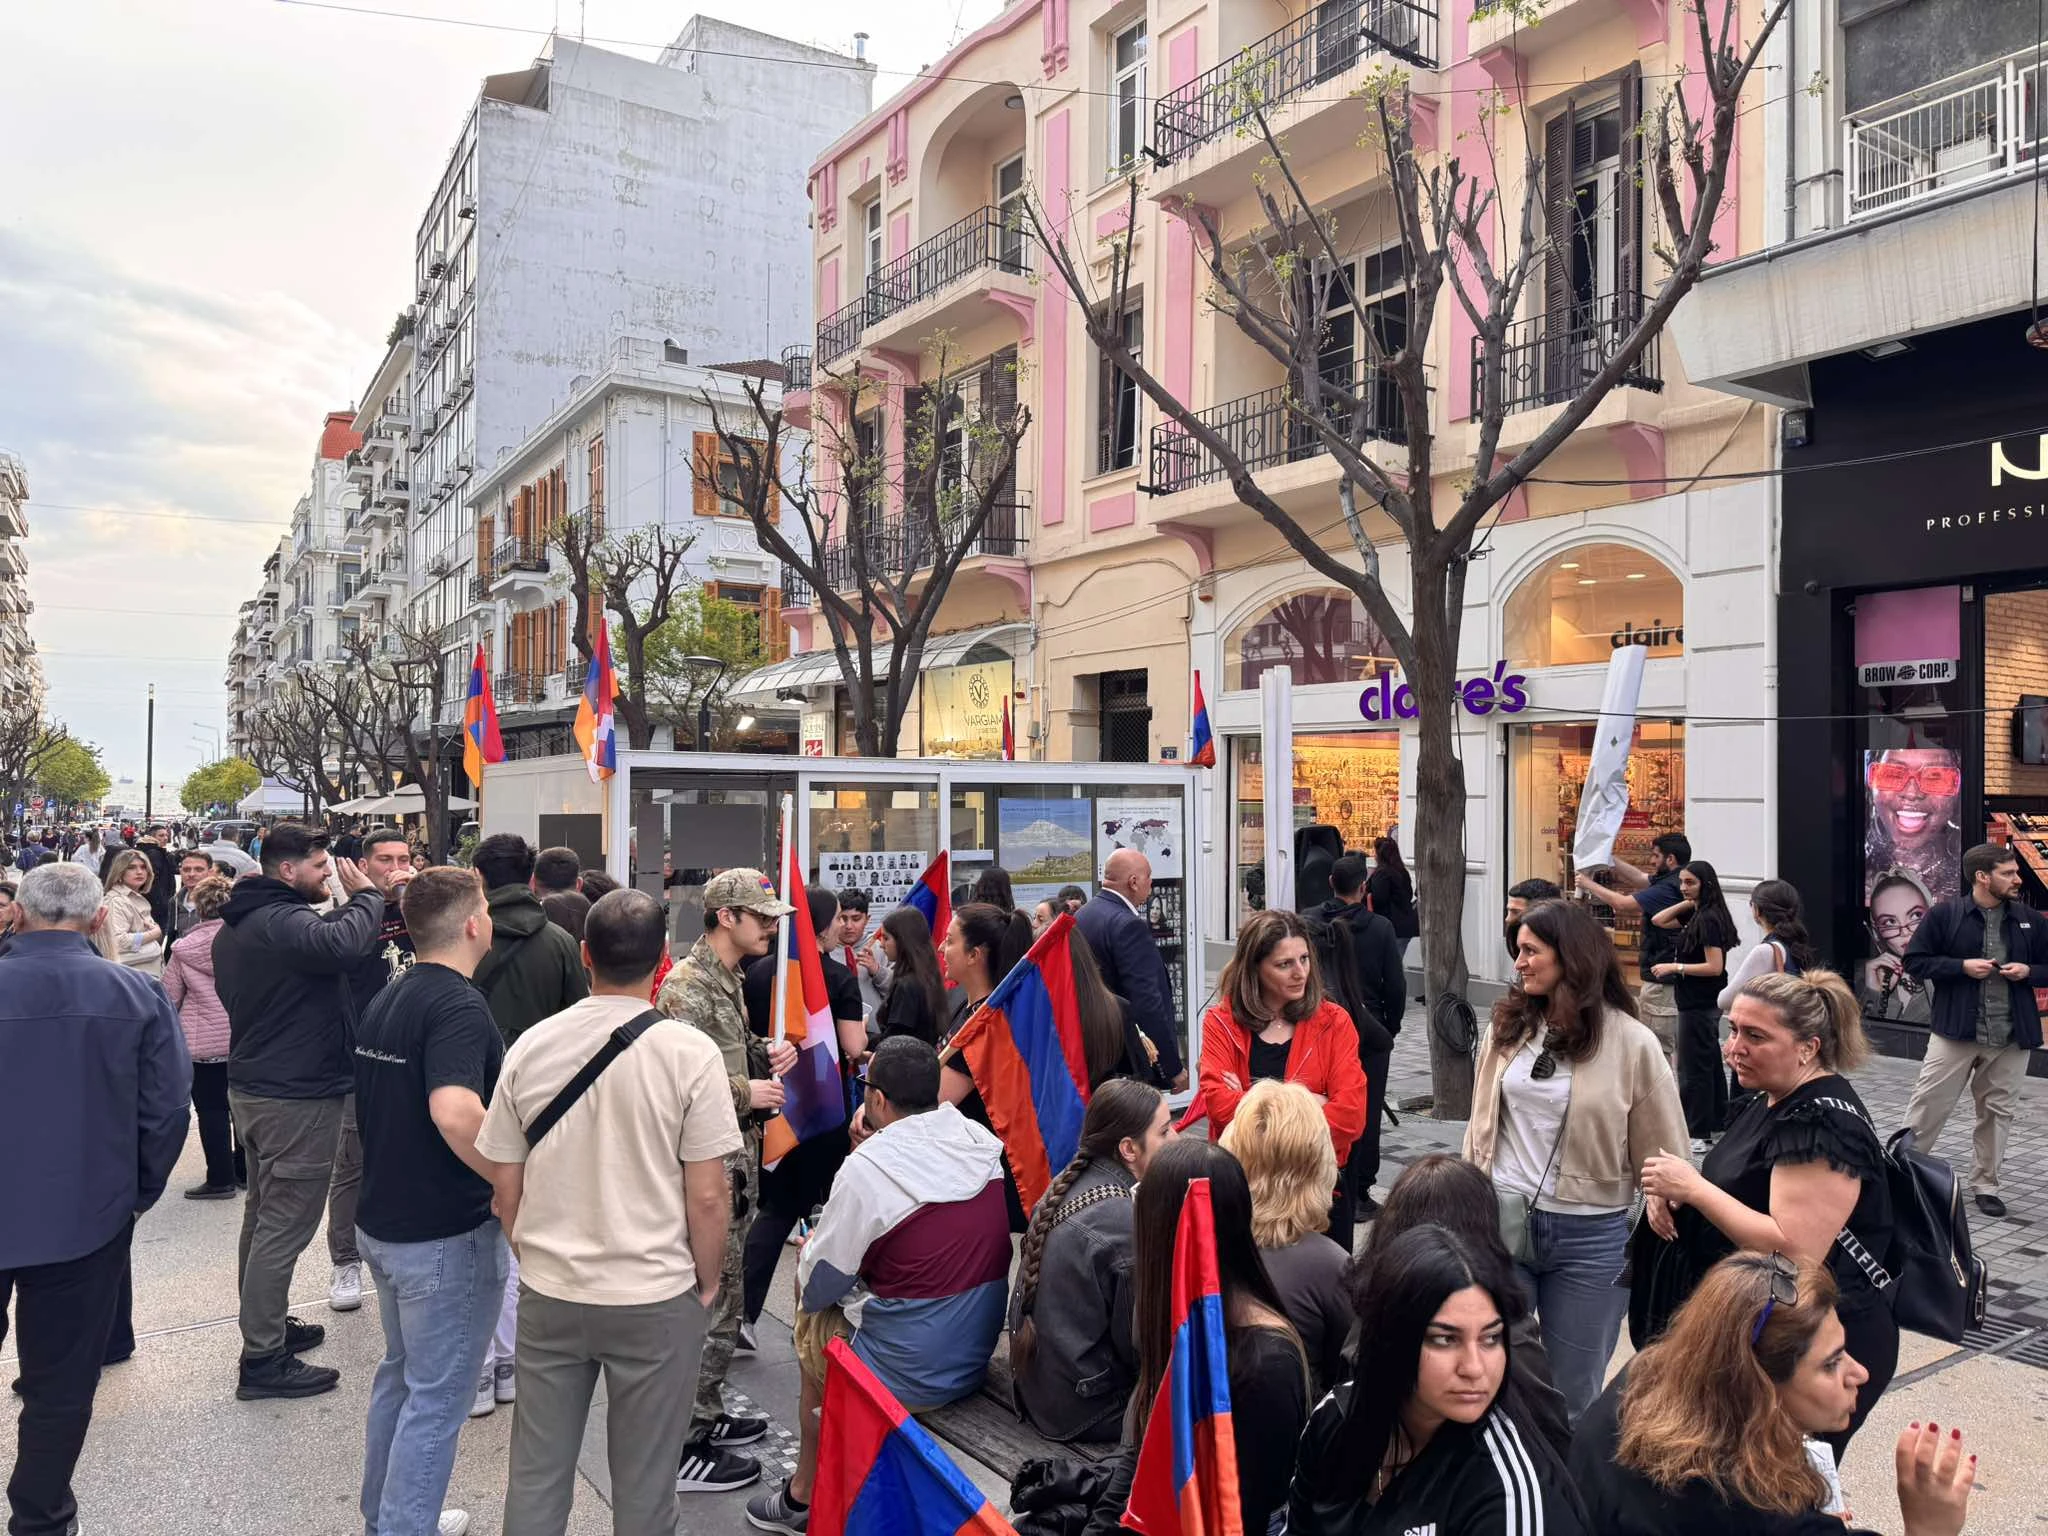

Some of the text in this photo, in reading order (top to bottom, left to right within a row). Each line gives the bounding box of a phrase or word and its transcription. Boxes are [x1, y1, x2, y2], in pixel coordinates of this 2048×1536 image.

[1926, 504, 2046, 531] PROFESSI
[1865, 662, 1950, 683] BROW CORP.
[1359, 660, 1528, 721] clae's
